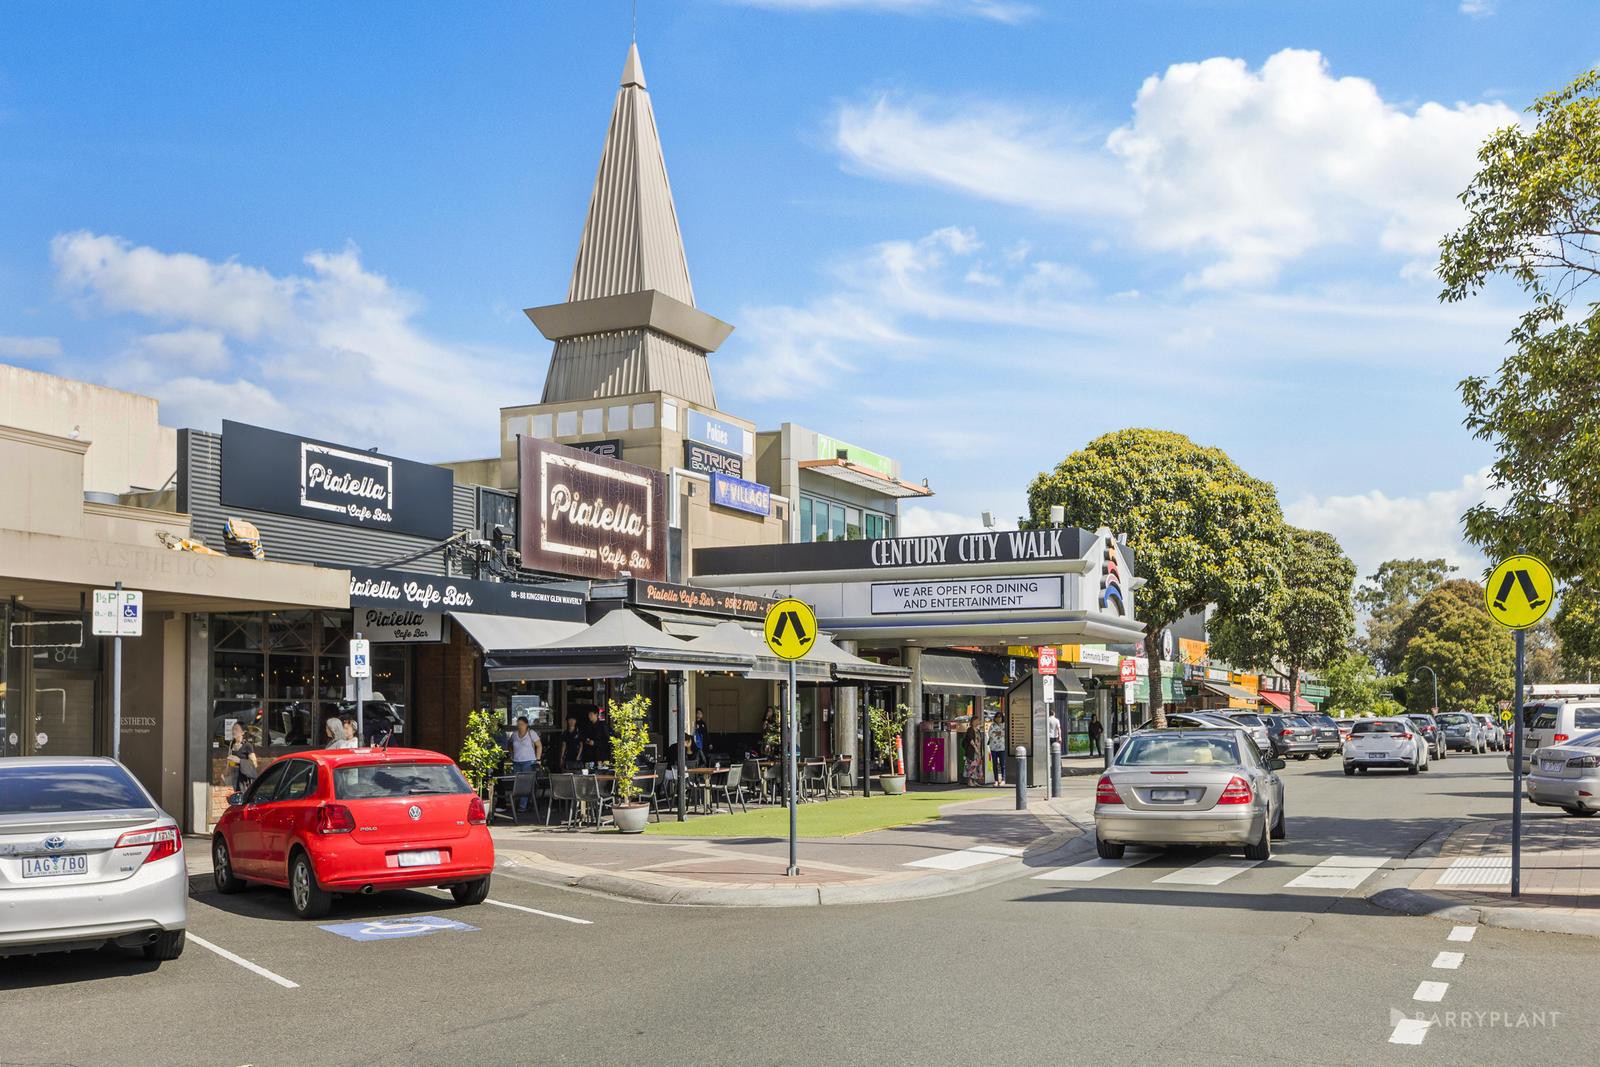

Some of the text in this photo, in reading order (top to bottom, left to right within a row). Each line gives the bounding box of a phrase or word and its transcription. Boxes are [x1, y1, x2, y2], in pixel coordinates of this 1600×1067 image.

[706, 422, 728, 446] Pokies
[691, 447, 741, 474] STRIKE
[308, 463, 387, 501] Piatella
[730, 483, 769, 508] VILLAGE
[347, 504, 392, 522] Cafe Bar
[550, 483, 645, 537] Piatella
[599, 545, 652, 570] Cafe Bar
[871, 530, 1063, 566] CENTURY CITY WALK
[126, 593, 136, 604] P
[350, 576, 401, 600] iatella
[403, 581, 441, 608] Cafe
[442, 585, 474, 606] Bar
[526, 592, 551, 602] KINGSWAY
[550, 595, 563, 604] GLEN
[647, 584, 679, 602] Piatella
[679, 590, 699, 608] Cafe
[699, 592, 716, 607] Bar
[893, 582, 1038, 598] WE ARE OPEN FOR DINING
[903, 595, 1024, 609] AND ENTERTAINMENT
[366, 610, 424, 628] Piatella
[394, 628, 429, 640] Cafe Bar
[54, 647, 78, 663] 84
